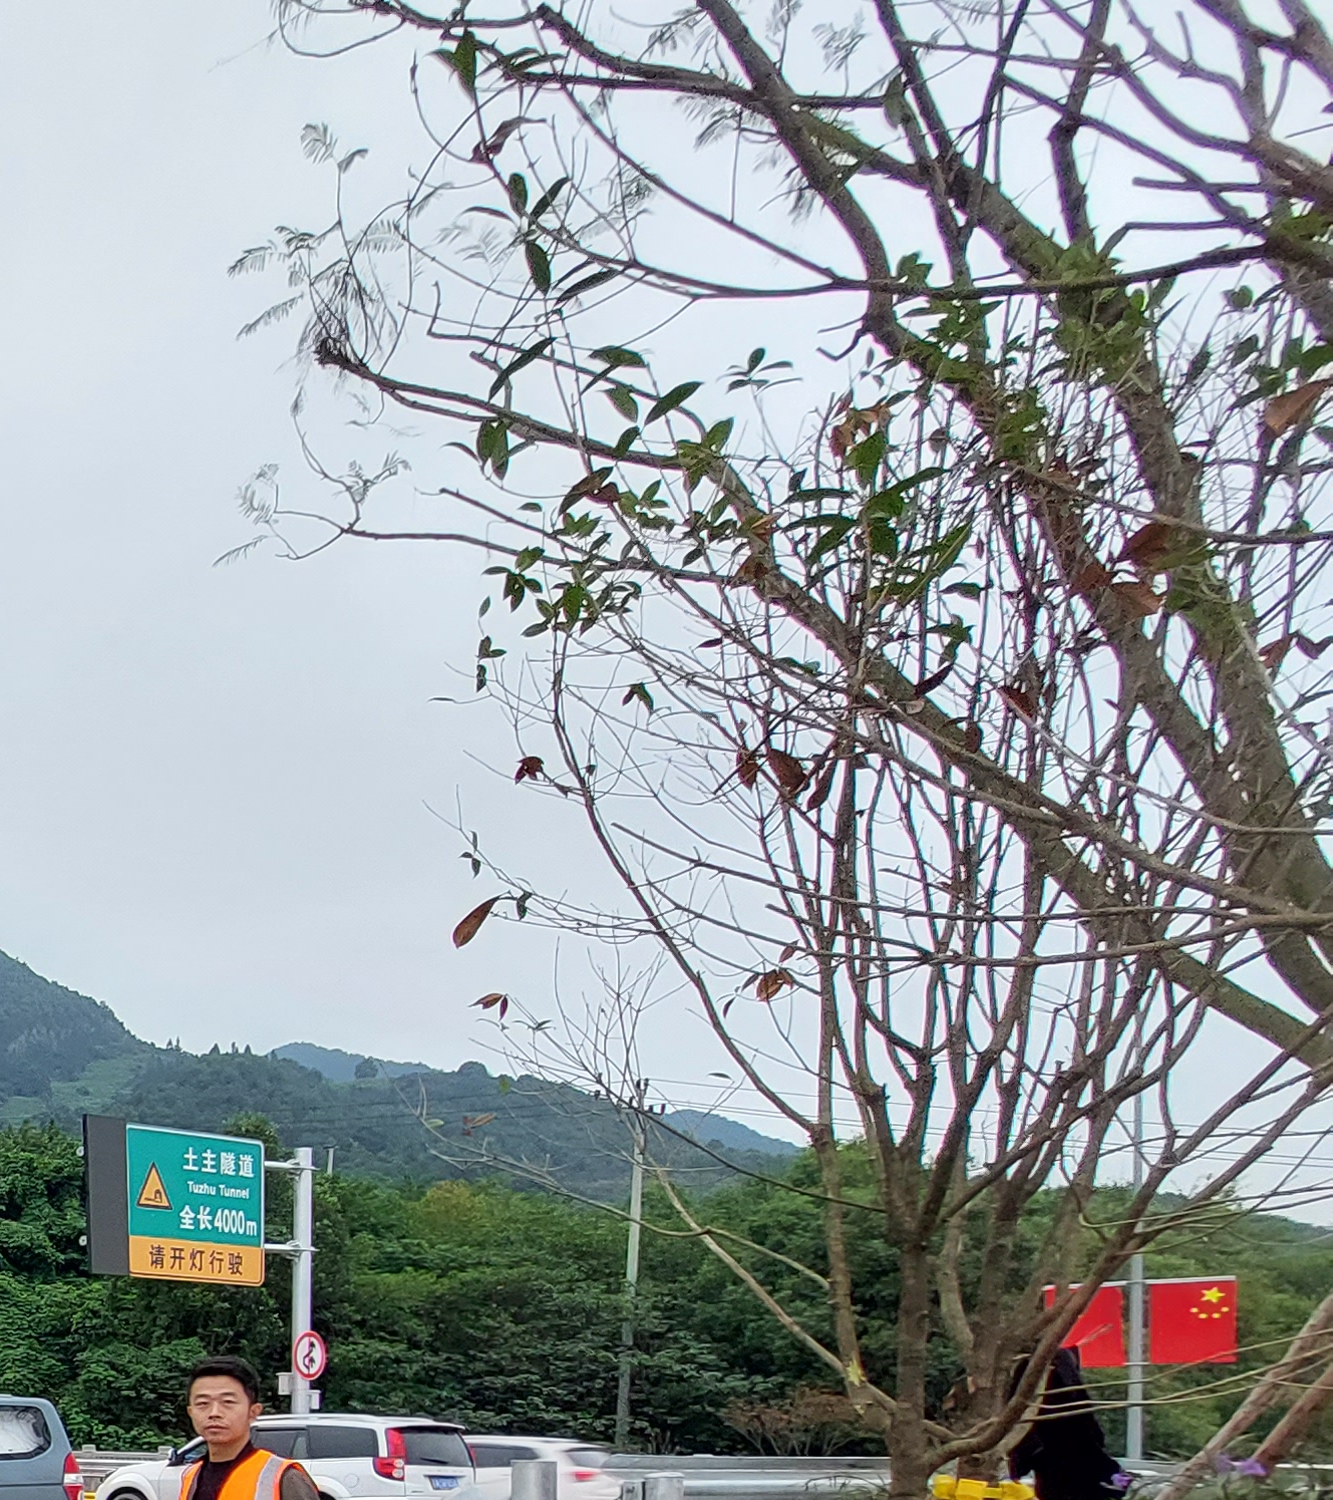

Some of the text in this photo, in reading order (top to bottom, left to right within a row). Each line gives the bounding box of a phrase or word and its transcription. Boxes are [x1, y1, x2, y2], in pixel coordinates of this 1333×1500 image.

[183, 1147, 255, 1178] 土主隧道
[187, 1181, 250, 1199] Tuzhu Tunnel
[179, 1205, 257, 1237] 全长4000m
[149, 1244, 243, 1276] 请开灯行驶
